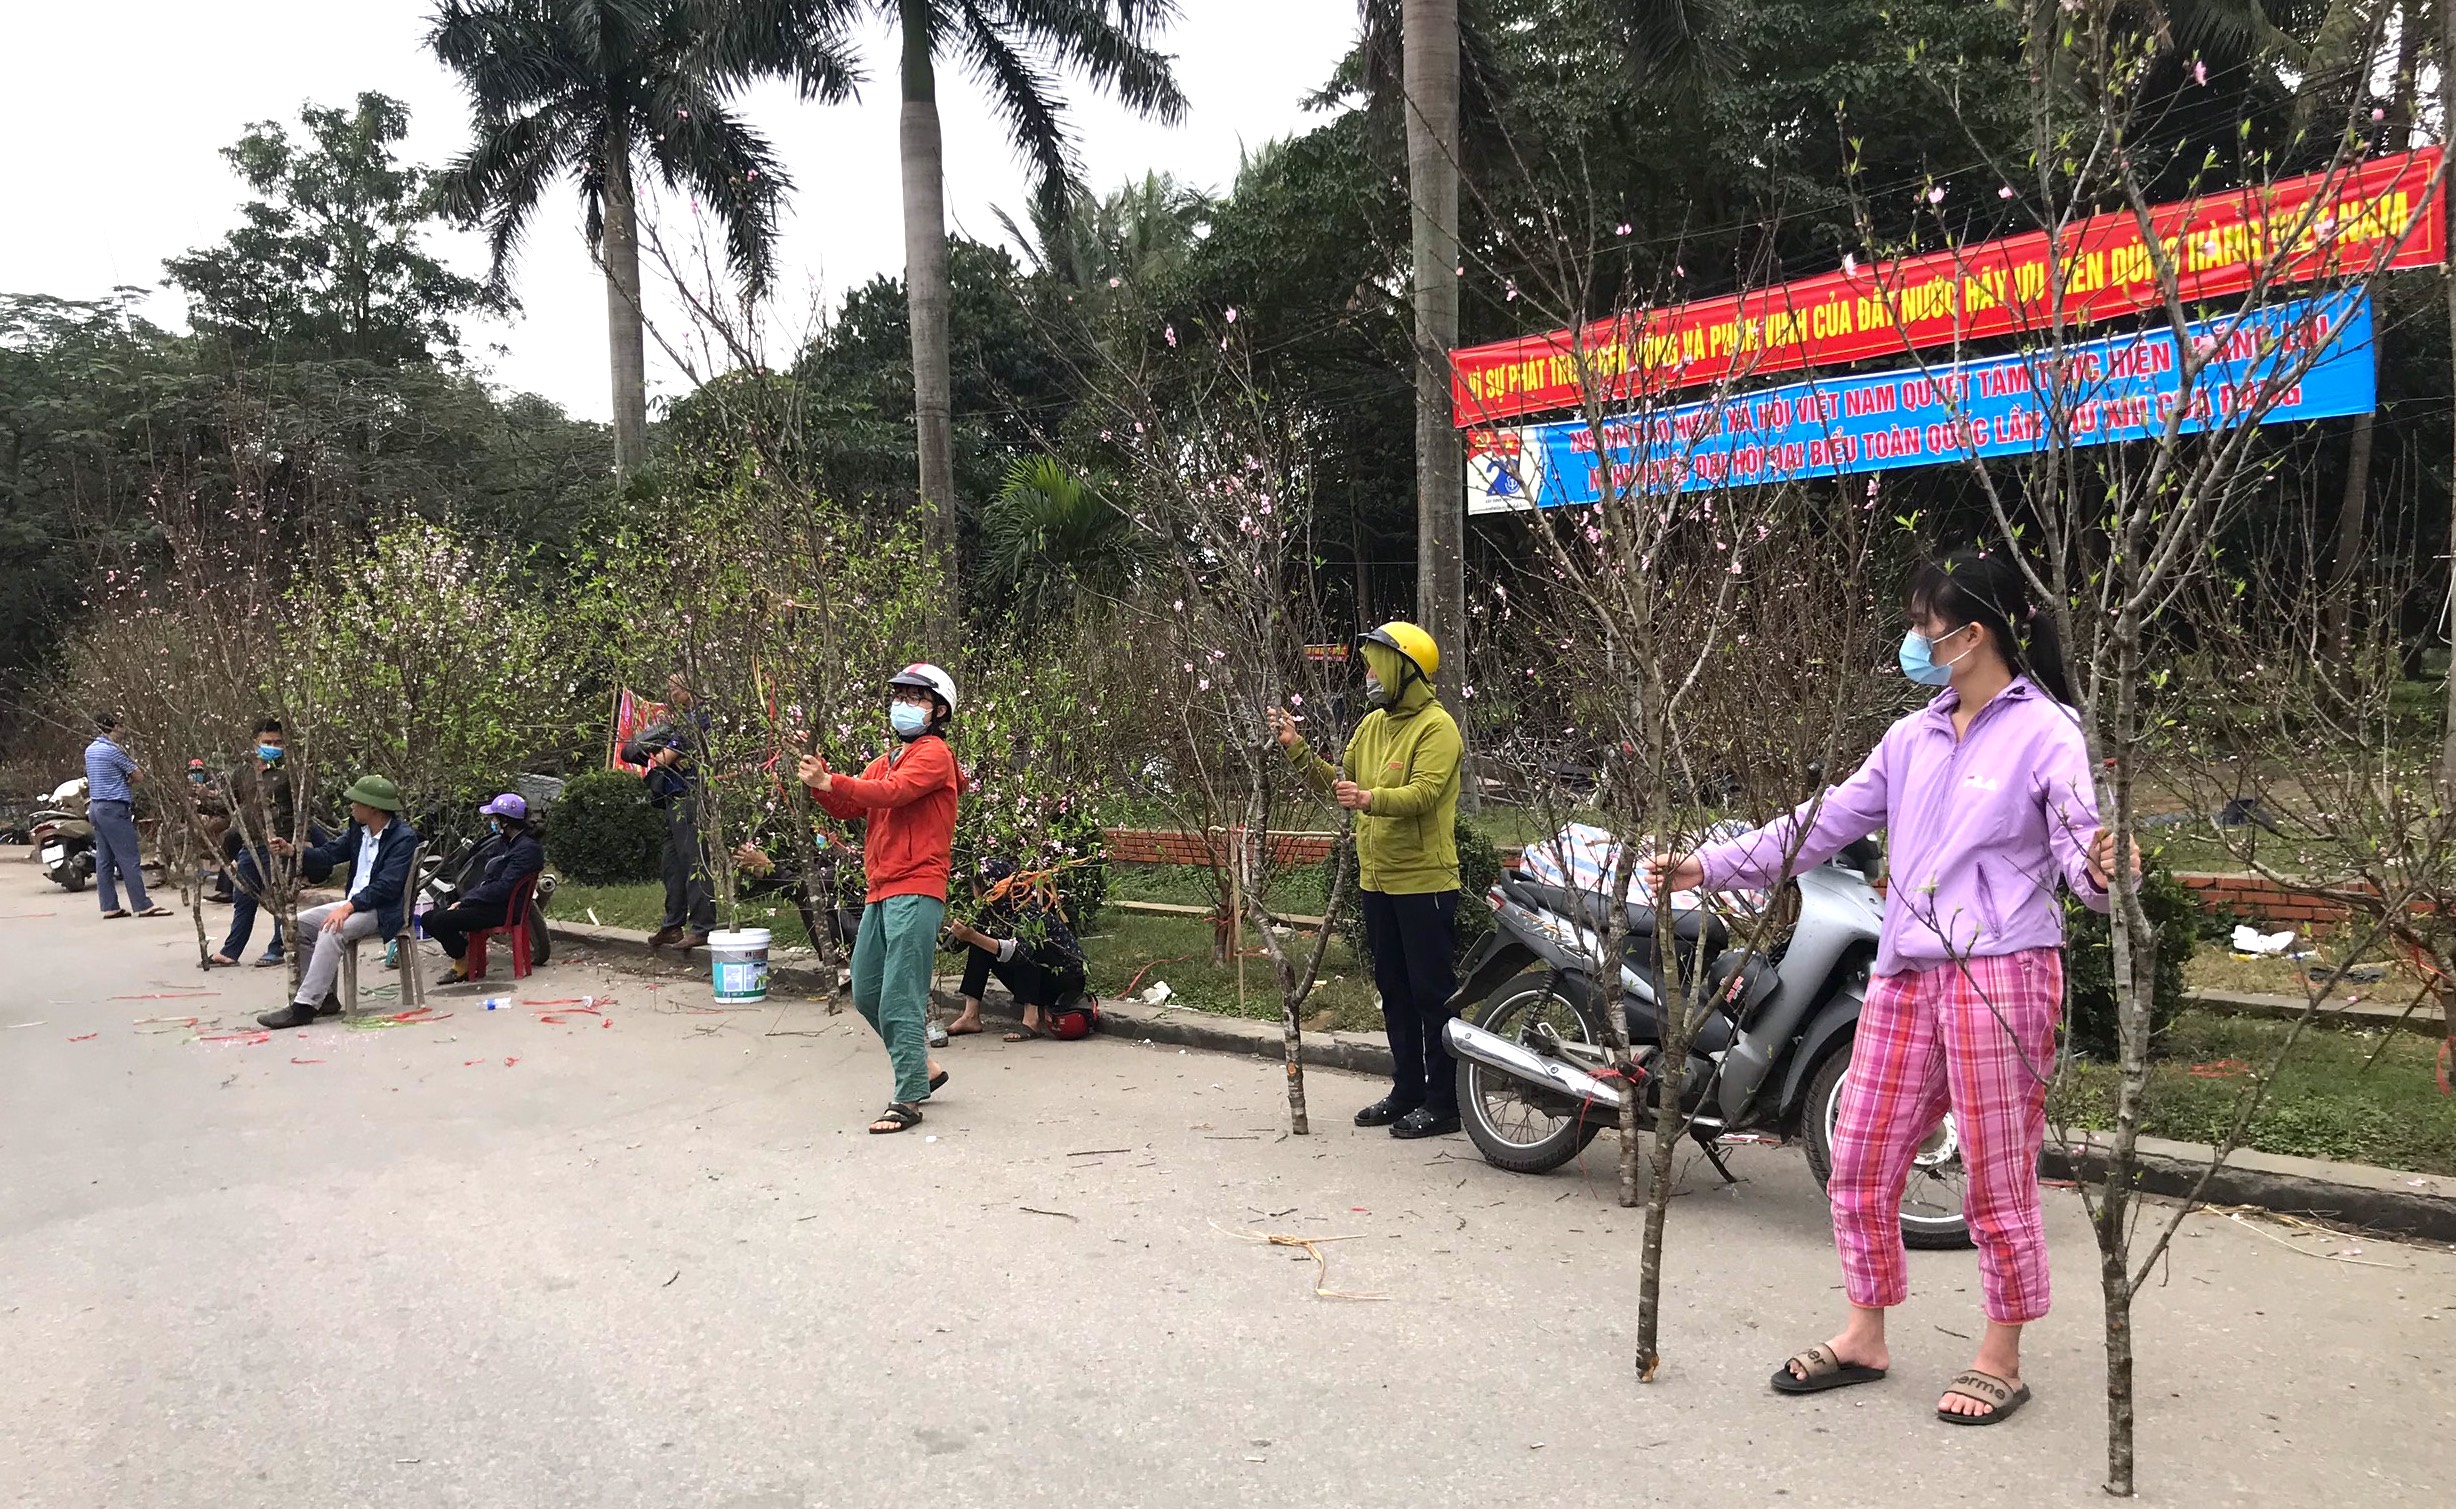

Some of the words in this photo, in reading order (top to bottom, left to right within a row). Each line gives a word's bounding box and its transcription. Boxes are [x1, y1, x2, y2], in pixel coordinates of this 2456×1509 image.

[1468, 366, 1483, 401] VÌ
[1486, 363, 1506, 403] SỰ
[1508, 355, 1545, 393] PHÁT
[1549, 347, 1593, 387] TRIN
[1683, 321, 1706, 362] VÀ
[1766, 308, 1808, 349] VINH
[1813, 291, 1853, 340] CỦA
[1857, 284, 1897, 332] ĐẤT
[1901, 274, 1956, 323] NƯỚC
[1964, 265, 2008, 312] HÃY
[2013, 260, 2045, 304] ƯU
[2052, 247, 2104, 295] IÊN
[2188, 220, 2261, 272] HÀNG
[2338, 191, 2408, 245] NAM
[1570, 424, 1631, 453] NGNH
[1758, 396, 1793, 432] HỘI
[1796, 389, 1839, 427] VIỆT
[1845, 384, 1896, 418] NAM
[1902, 369, 1971, 410] QUYẾT
[1976, 362, 2030, 398] TÂM
[2107, 338, 2171, 381] HIỆN
[1733, 445, 1766, 480] HỘI
[1809, 425, 1858, 466] BIỂU
[1863, 423, 1920, 459] TOÀN
[1994, 402, 2042, 444] LẦN
